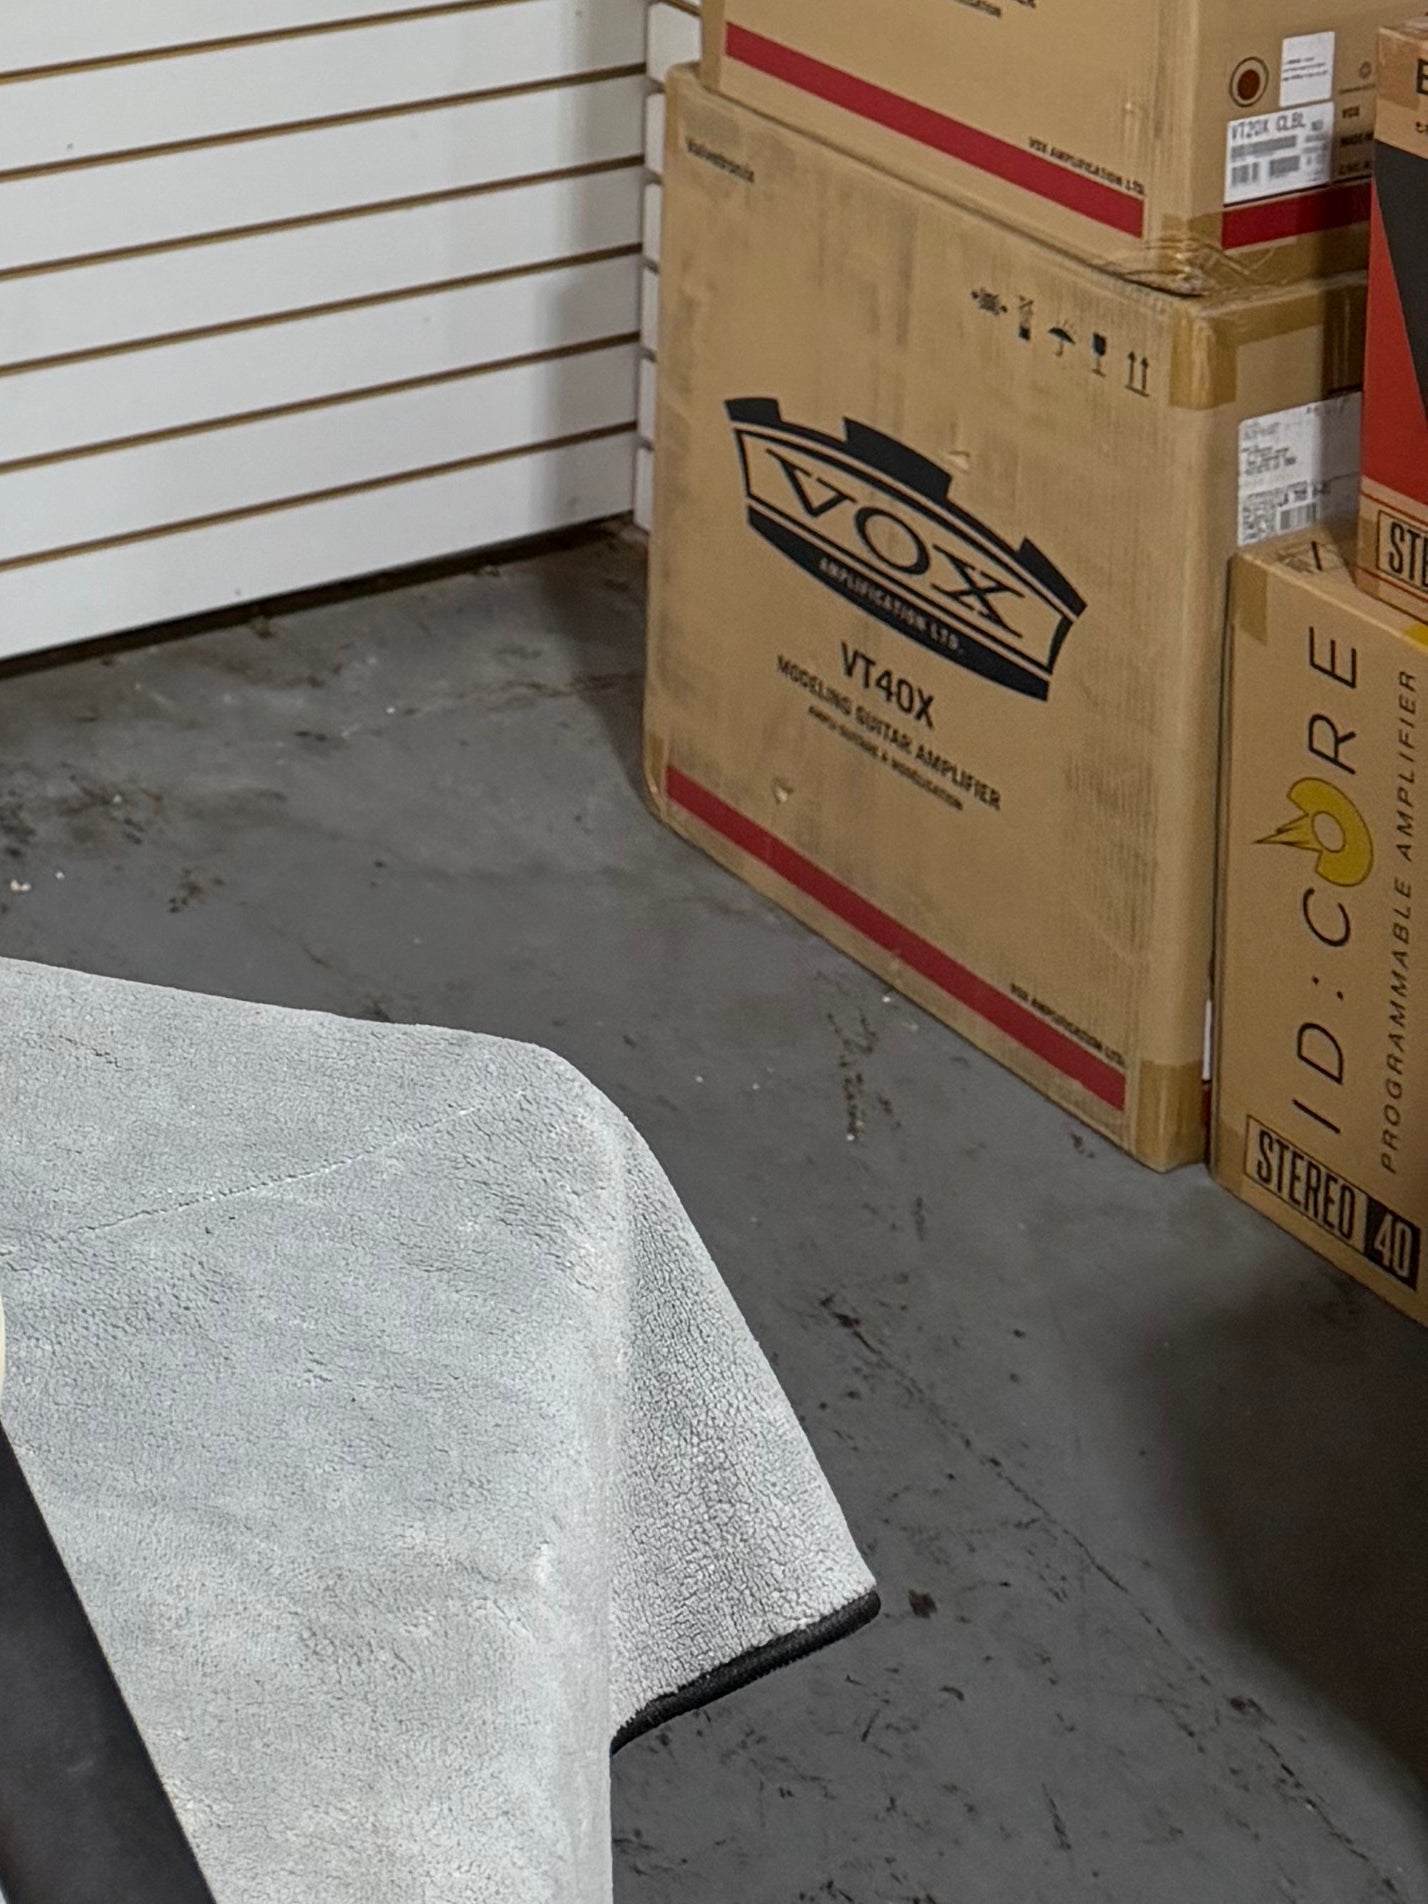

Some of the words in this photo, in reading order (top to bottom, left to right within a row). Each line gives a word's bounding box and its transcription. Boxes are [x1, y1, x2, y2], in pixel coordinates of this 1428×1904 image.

[766, 448, 1025, 639] VOX
[820, 557, 927, 631] AMPLIFICATION
[777, 654, 852, 716] MODELING
[855, 705, 912, 753] GUITAR
[916, 744, 1001, 811] AMPLIFIER
[841, 642, 935, 730] VT40X
[1390, 670, 1417, 864] AMPLIFIER
[1380, 876, 1413, 1175] PROGRAMMABLE
[1255, 1128, 1356, 1242] STEREO
[1373, 1215, 1413, 1280] 40
